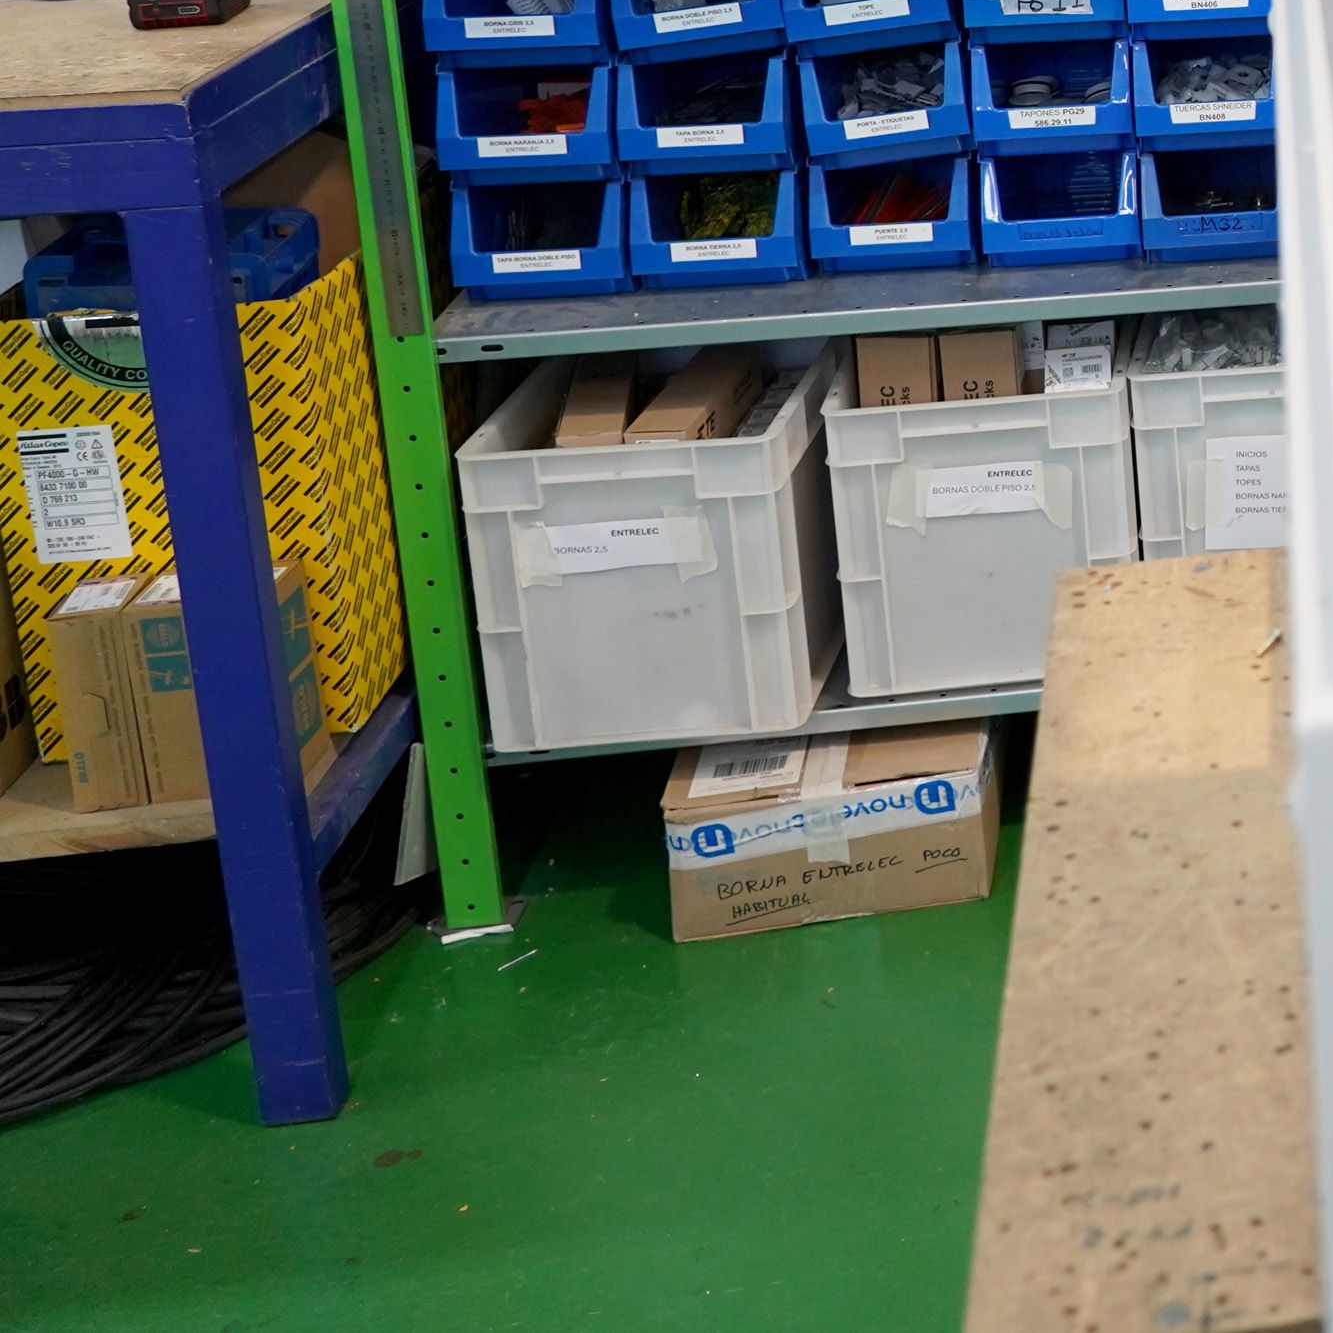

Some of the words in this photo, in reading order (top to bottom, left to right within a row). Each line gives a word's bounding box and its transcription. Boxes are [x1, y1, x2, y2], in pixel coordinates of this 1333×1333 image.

[1191, 1, 1218, 9] BN406
[1020, 109, 1060, 117] TAPONES
[1062, 107, 1085, 115] PG29
[62, 339, 121, 377] QUALITY
[987, 469, 1033, 478] ENTRELEC
[1235, 478, 1262, 486] TOPES
[932, 486, 969, 495] BORNAS
[971, 485, 1000, 494] DOBLE
[1002, 484, 1022, 493] PISO
[611, 528, 659, 537] ENTRELEC
[717, 876, 787, 900] BORNA
[802, 856, 904, 885] ENTRELEC
[921, 846, 962, 863] POCO
[732, 890, 811, 918] HABITUAL
